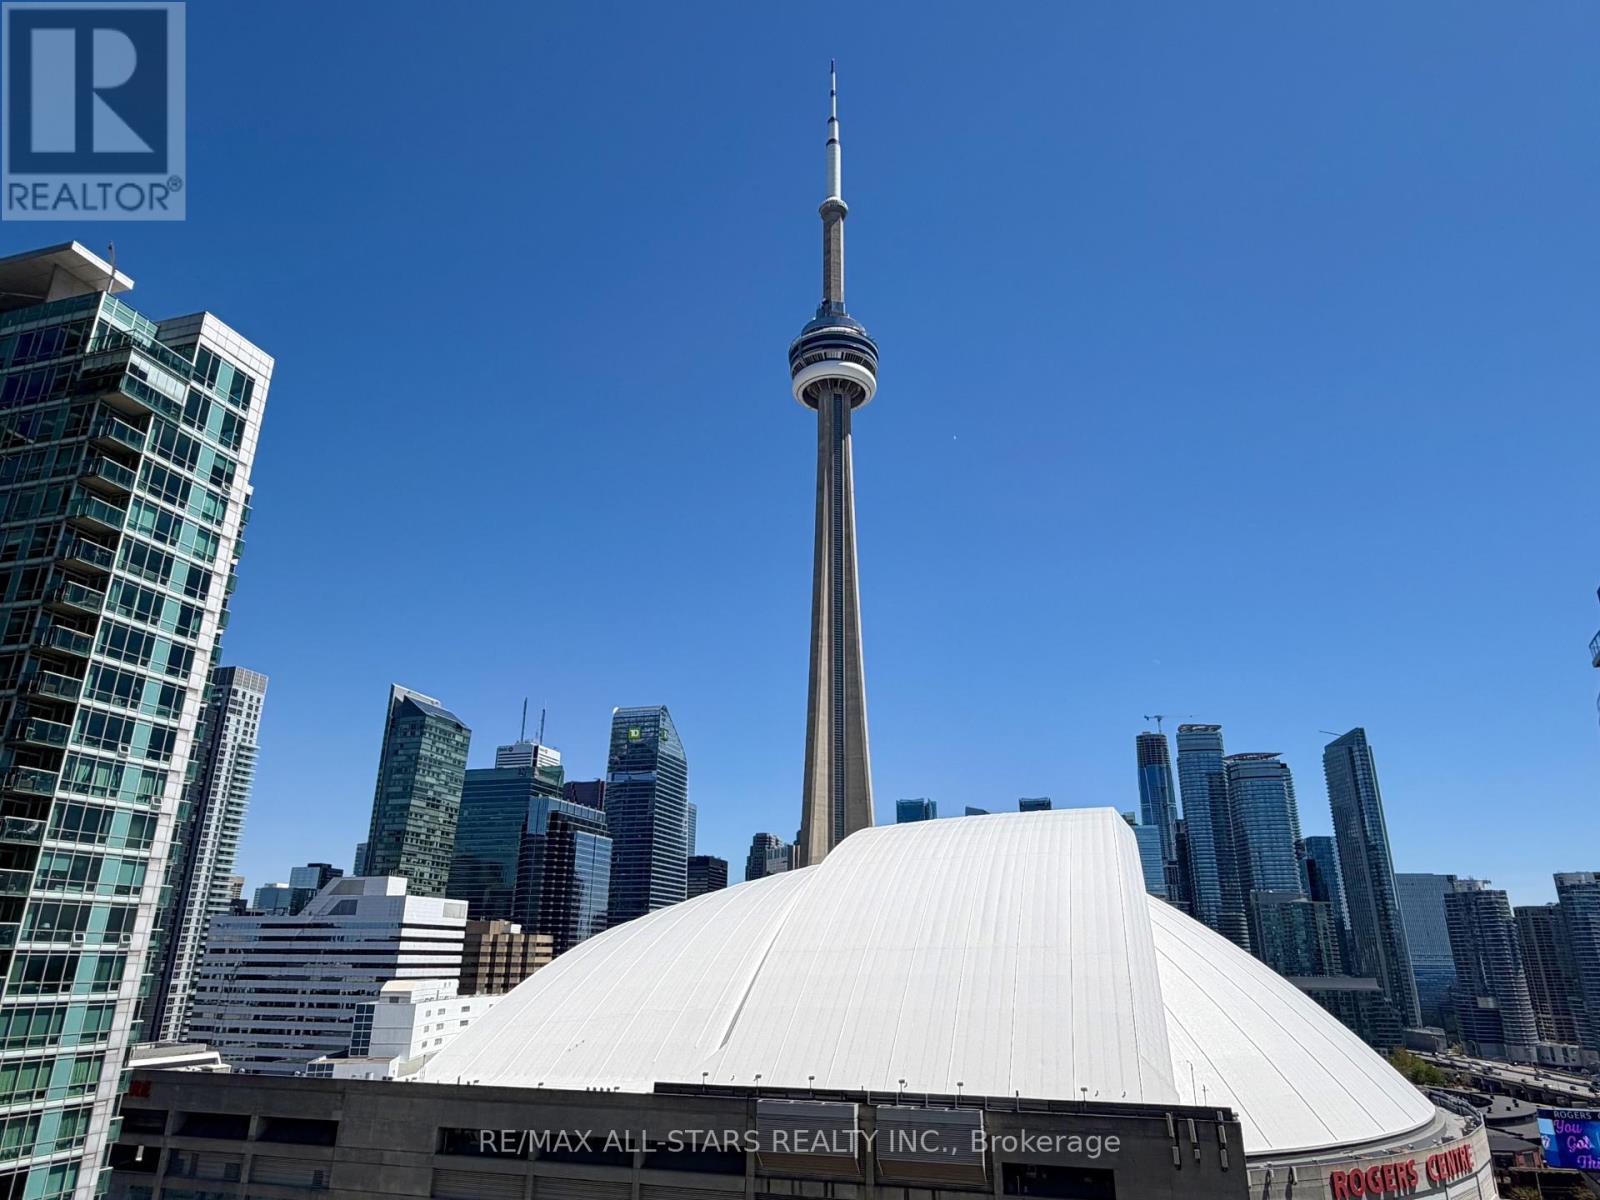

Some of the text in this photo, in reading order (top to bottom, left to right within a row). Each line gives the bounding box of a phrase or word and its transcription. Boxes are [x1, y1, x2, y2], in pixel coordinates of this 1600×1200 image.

[1553, 1110, 1592, 1120] ROGERS
[1553, 1119, 1583, 1134] You
[1331, 1143, 1474, 1200] ROGERS CENTRE
